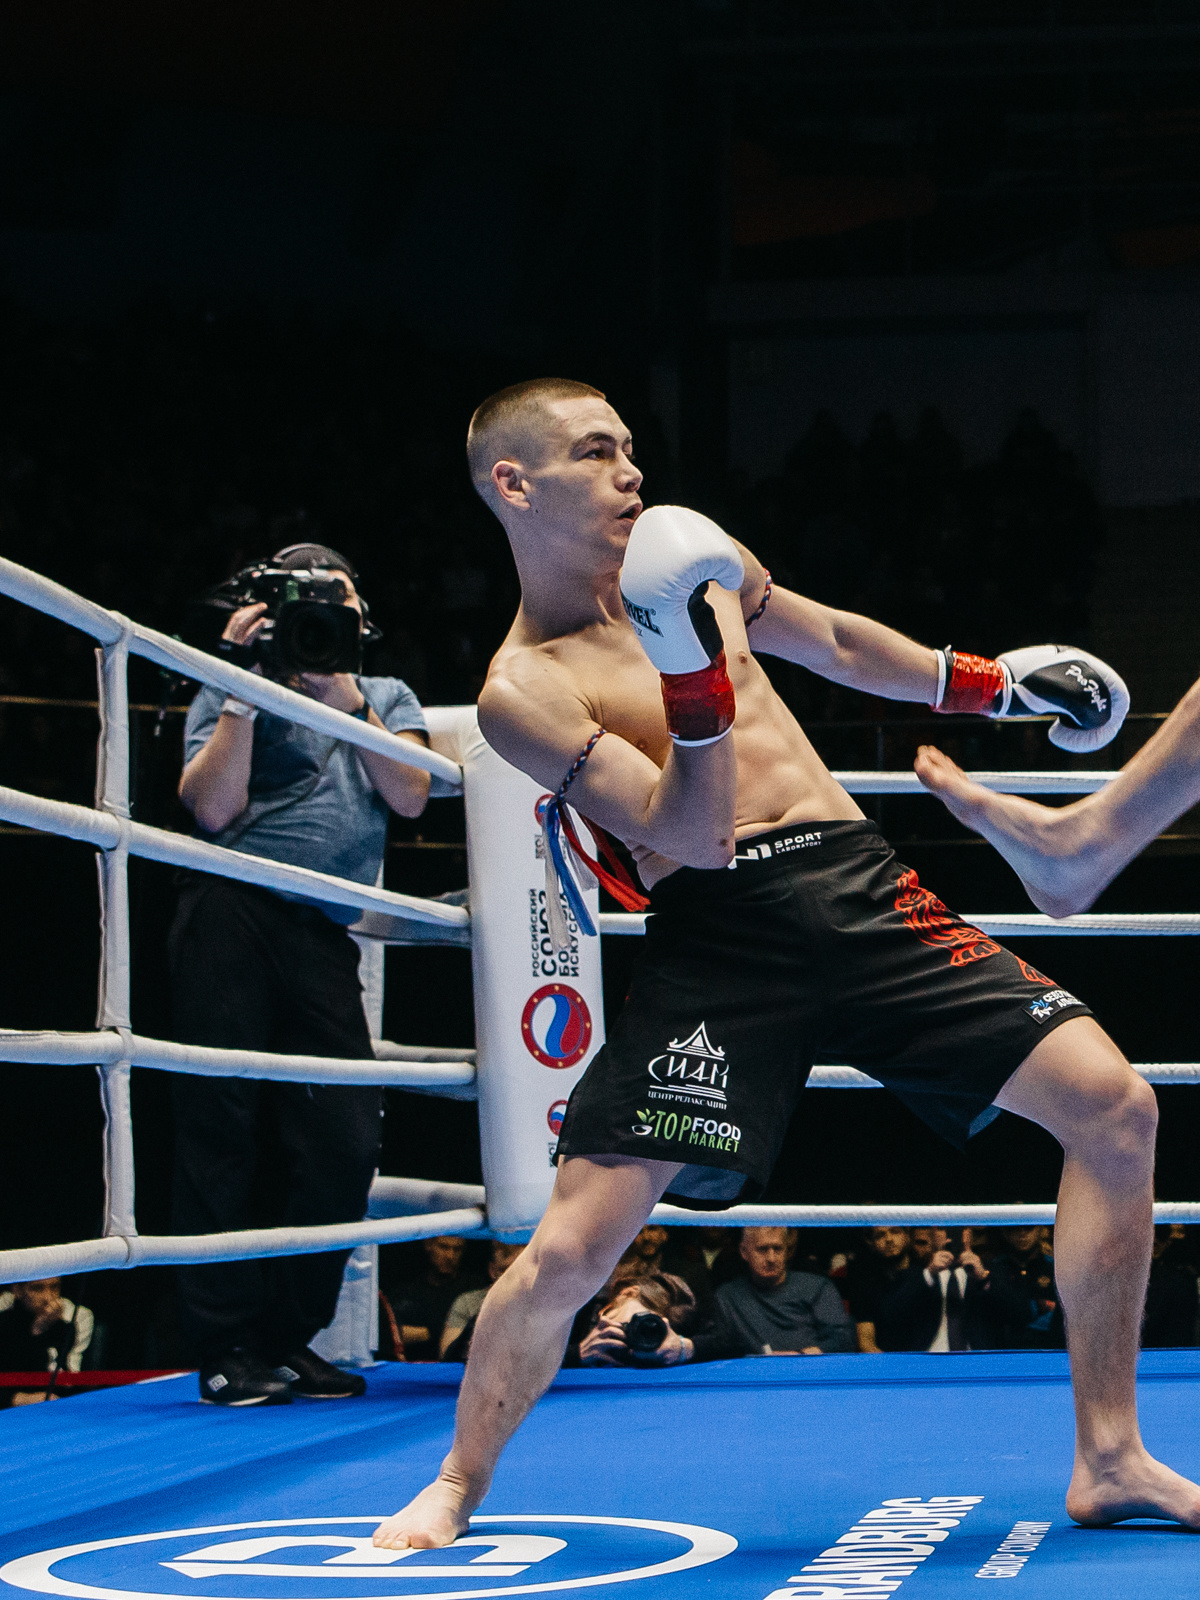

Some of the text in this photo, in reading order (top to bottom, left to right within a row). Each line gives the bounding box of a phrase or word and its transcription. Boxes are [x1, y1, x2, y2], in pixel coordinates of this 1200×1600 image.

[774, 832, 822, 849] SPORT
[776, 841, 822, 854] LABORATORY
[529, 888, 540, 978] РОССИЙСКИЙ
[648, 1090, 727, 1110] ЦЕНТР РЕЛАКСАЦИИ
[688, 1132, 740, 1153] MARKET
[974, 1521, 1052, 1579] GROUP COMPANY
